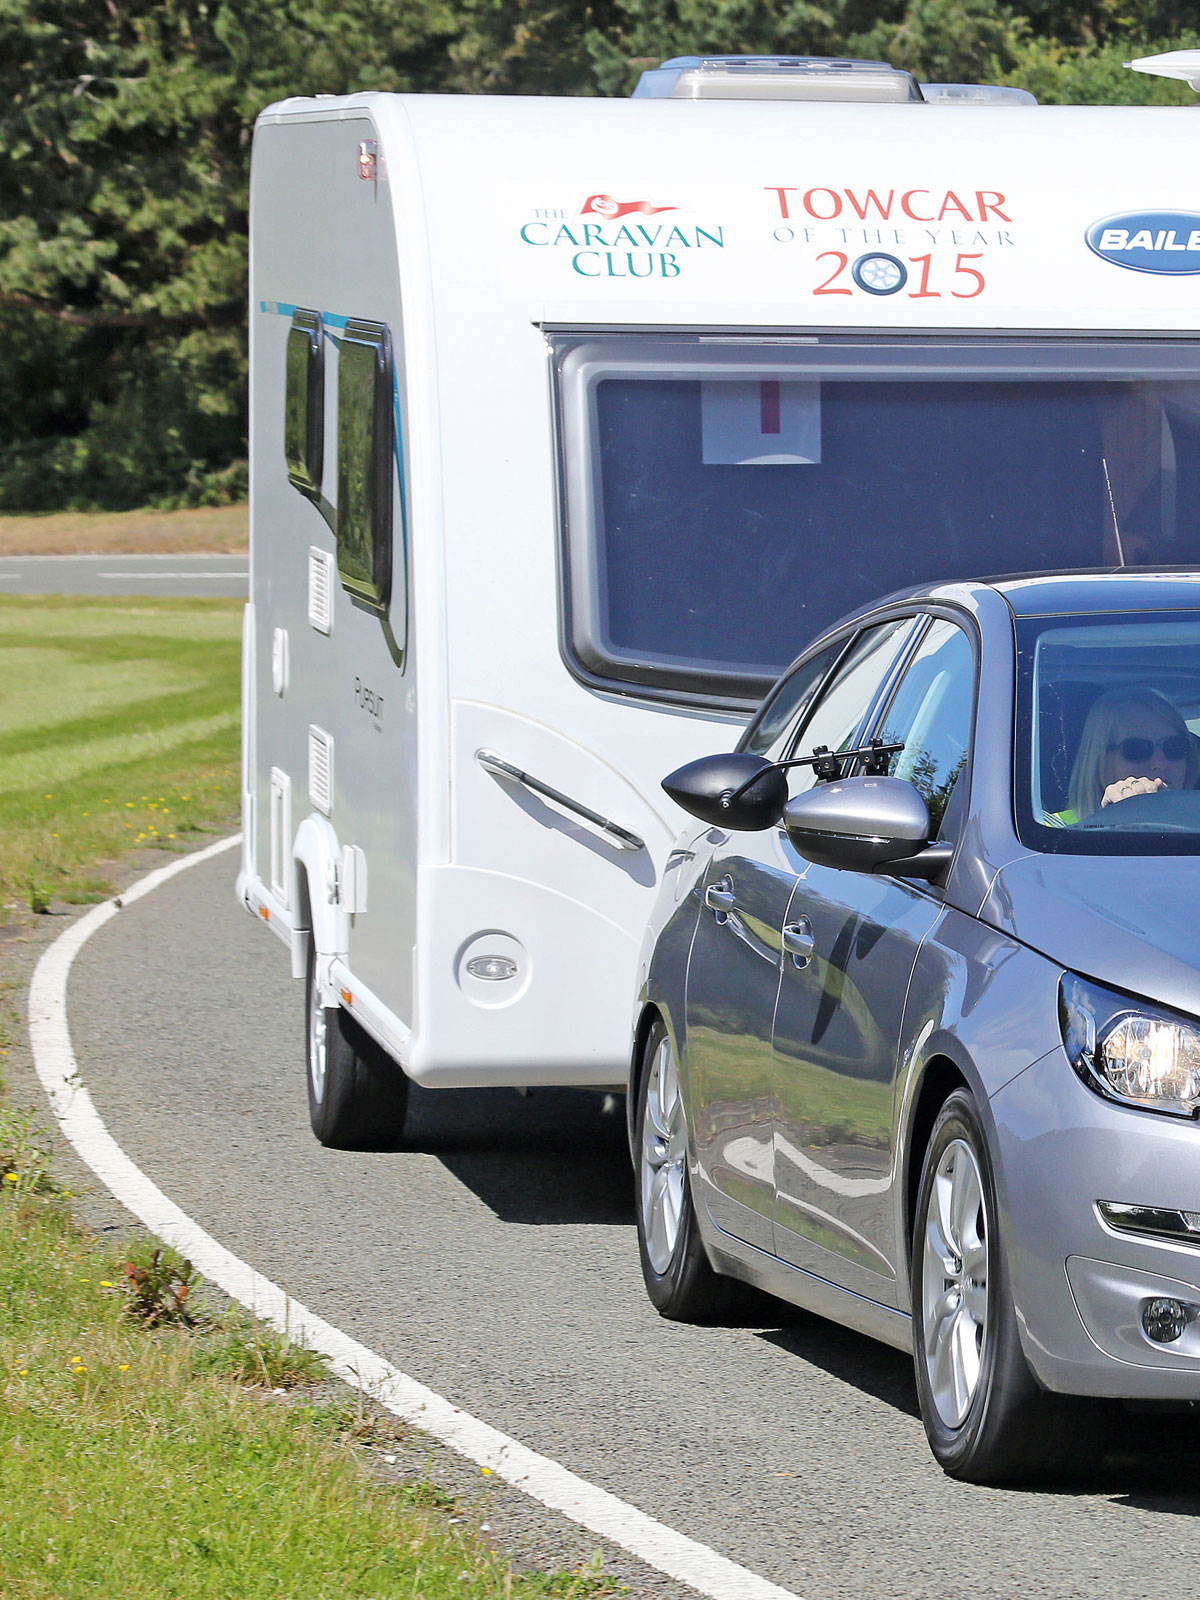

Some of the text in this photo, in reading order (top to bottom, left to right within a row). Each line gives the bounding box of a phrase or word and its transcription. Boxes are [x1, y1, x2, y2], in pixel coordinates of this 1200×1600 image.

[532, 208, 569, 219] THE
[763, 187, 1013, 222] TOWCAR
[520, 222, 725, 249] CARAVAN
[773, 227, 1016, 246] OF THE YEAR
[572, 251, 681, 278] CLUB
